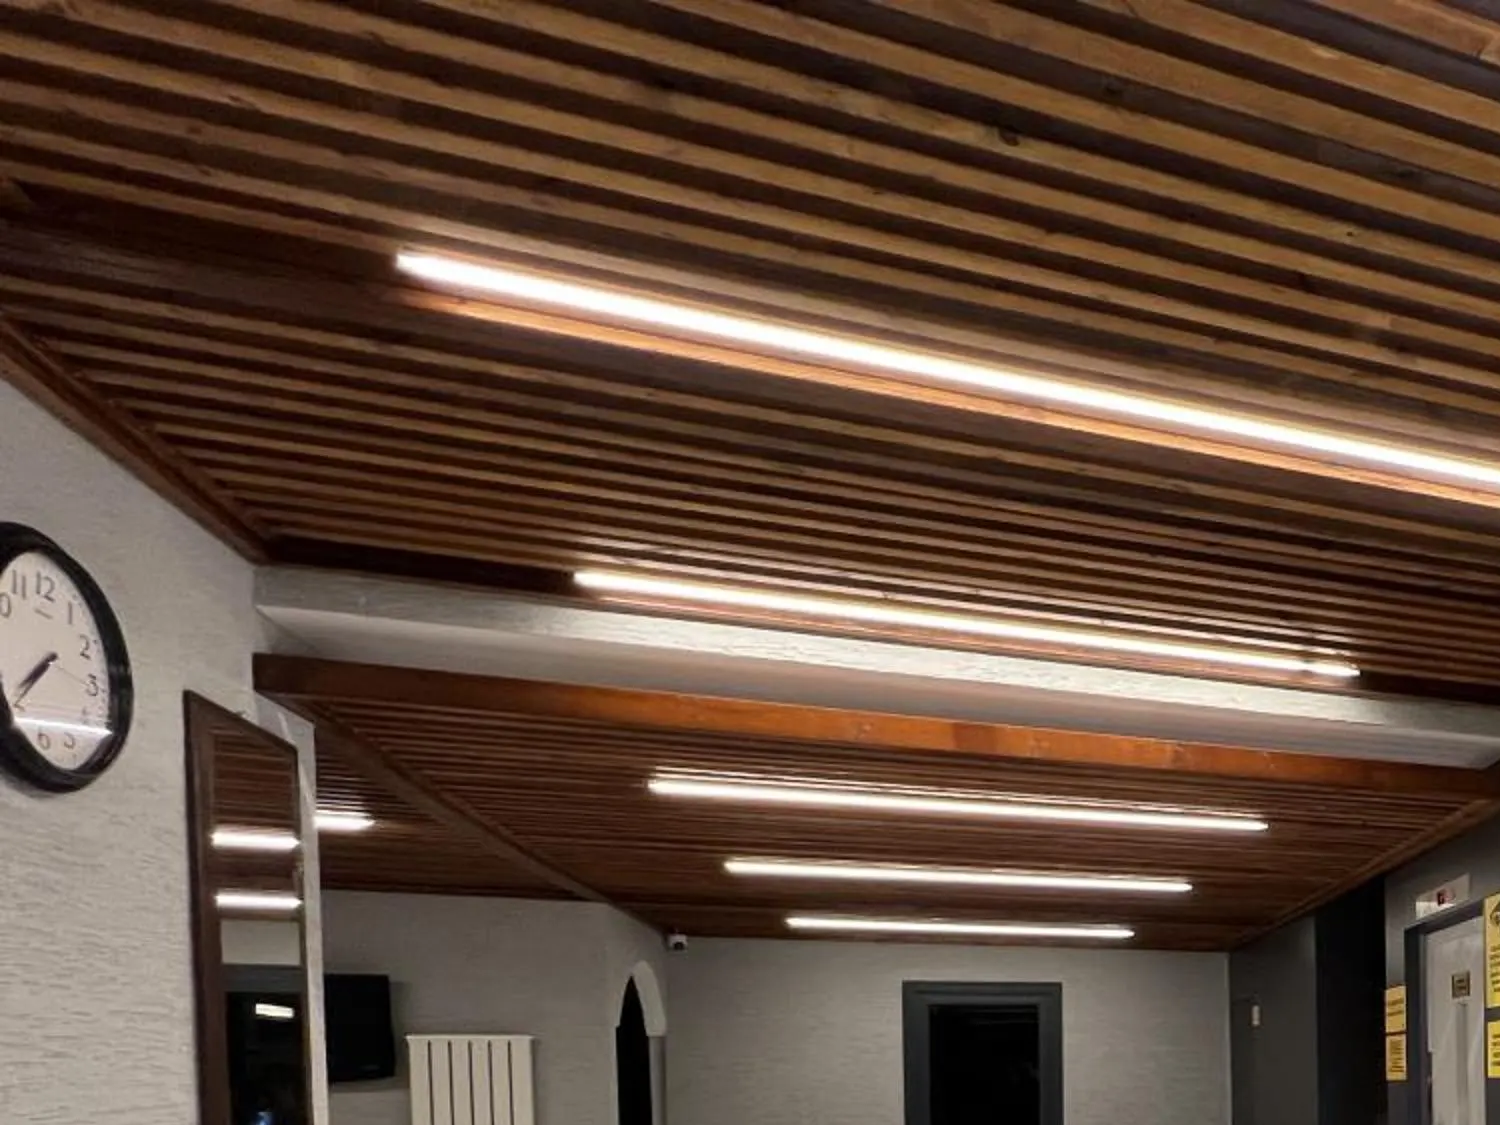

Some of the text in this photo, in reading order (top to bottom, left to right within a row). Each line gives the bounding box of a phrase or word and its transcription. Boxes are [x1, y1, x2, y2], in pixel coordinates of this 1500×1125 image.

[36, 570, 57, 603] 12
[67, 601, 74, 626] 1
[79, 633, 92, 661] 2
[85, 672, 99, 698] 3
